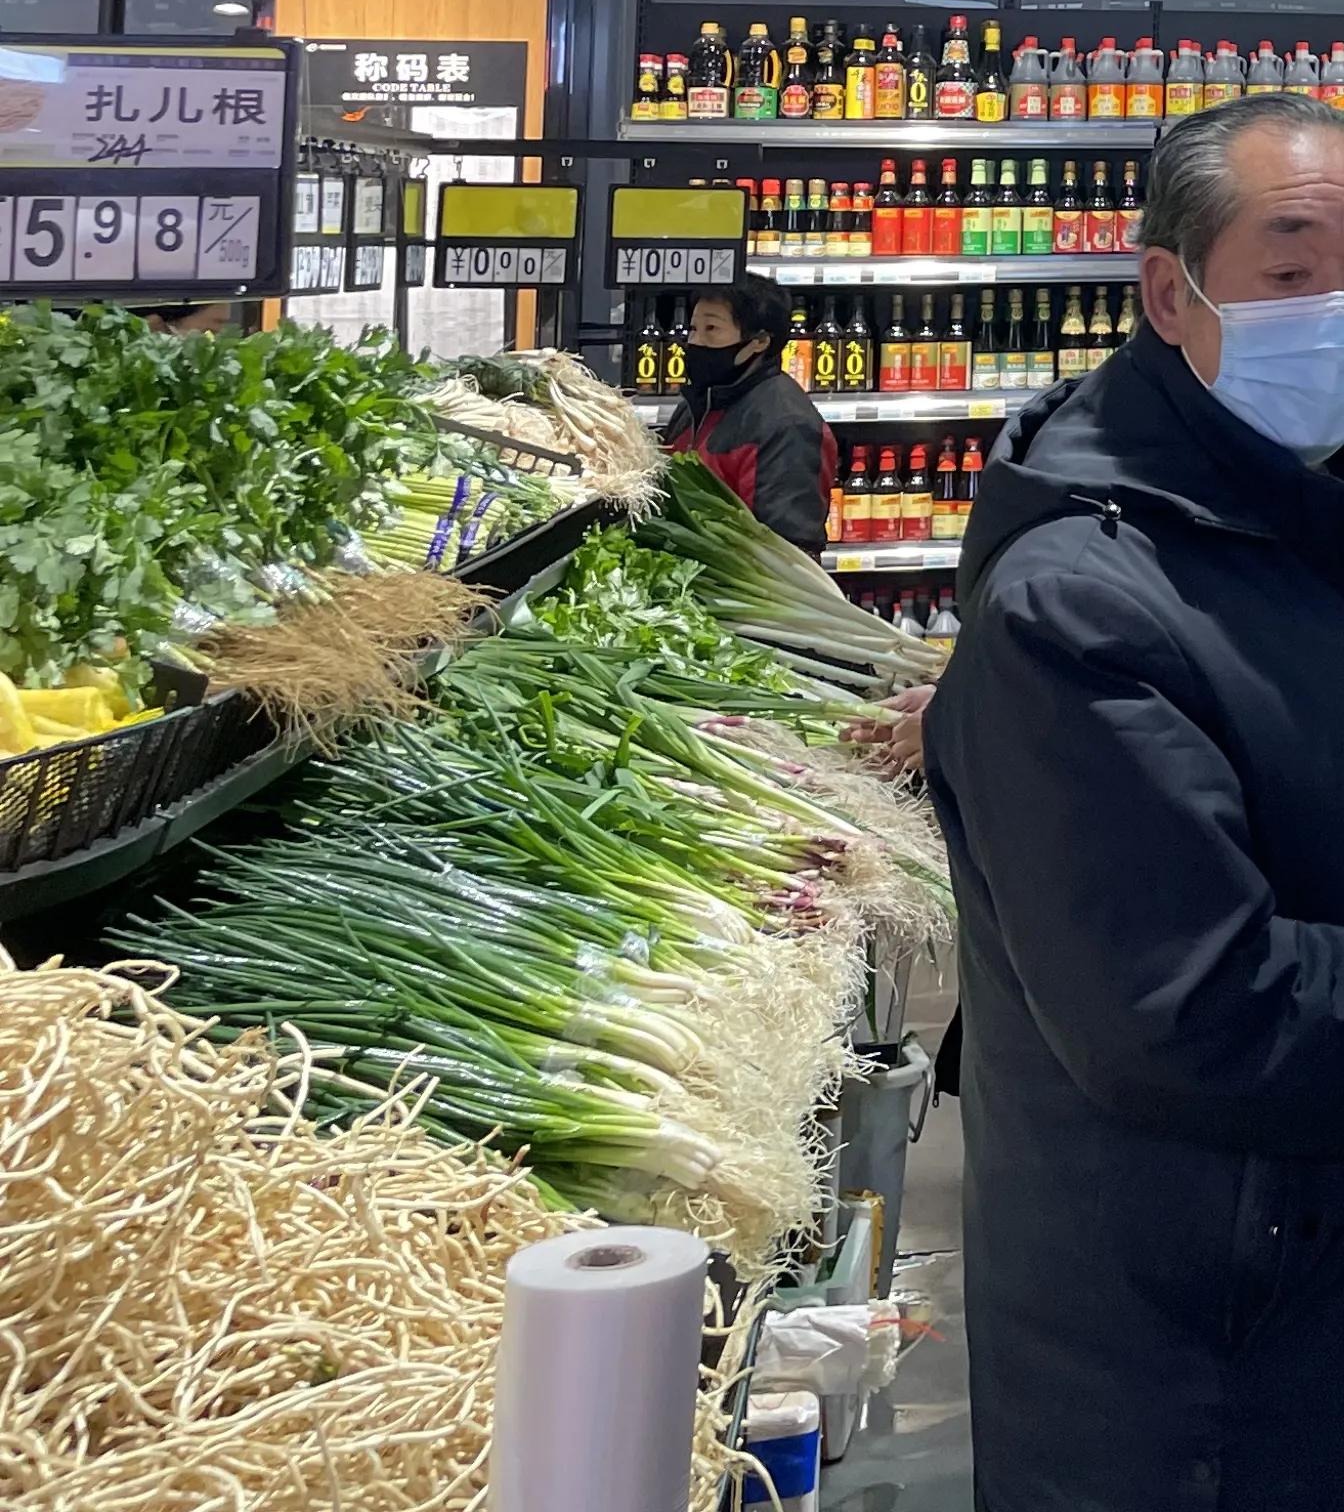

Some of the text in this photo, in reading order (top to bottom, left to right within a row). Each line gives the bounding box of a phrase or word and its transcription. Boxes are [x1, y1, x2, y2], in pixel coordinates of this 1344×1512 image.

[354, 53, 470, 82] 称码表
[372, 83, 452, 93] CODE TABLE
